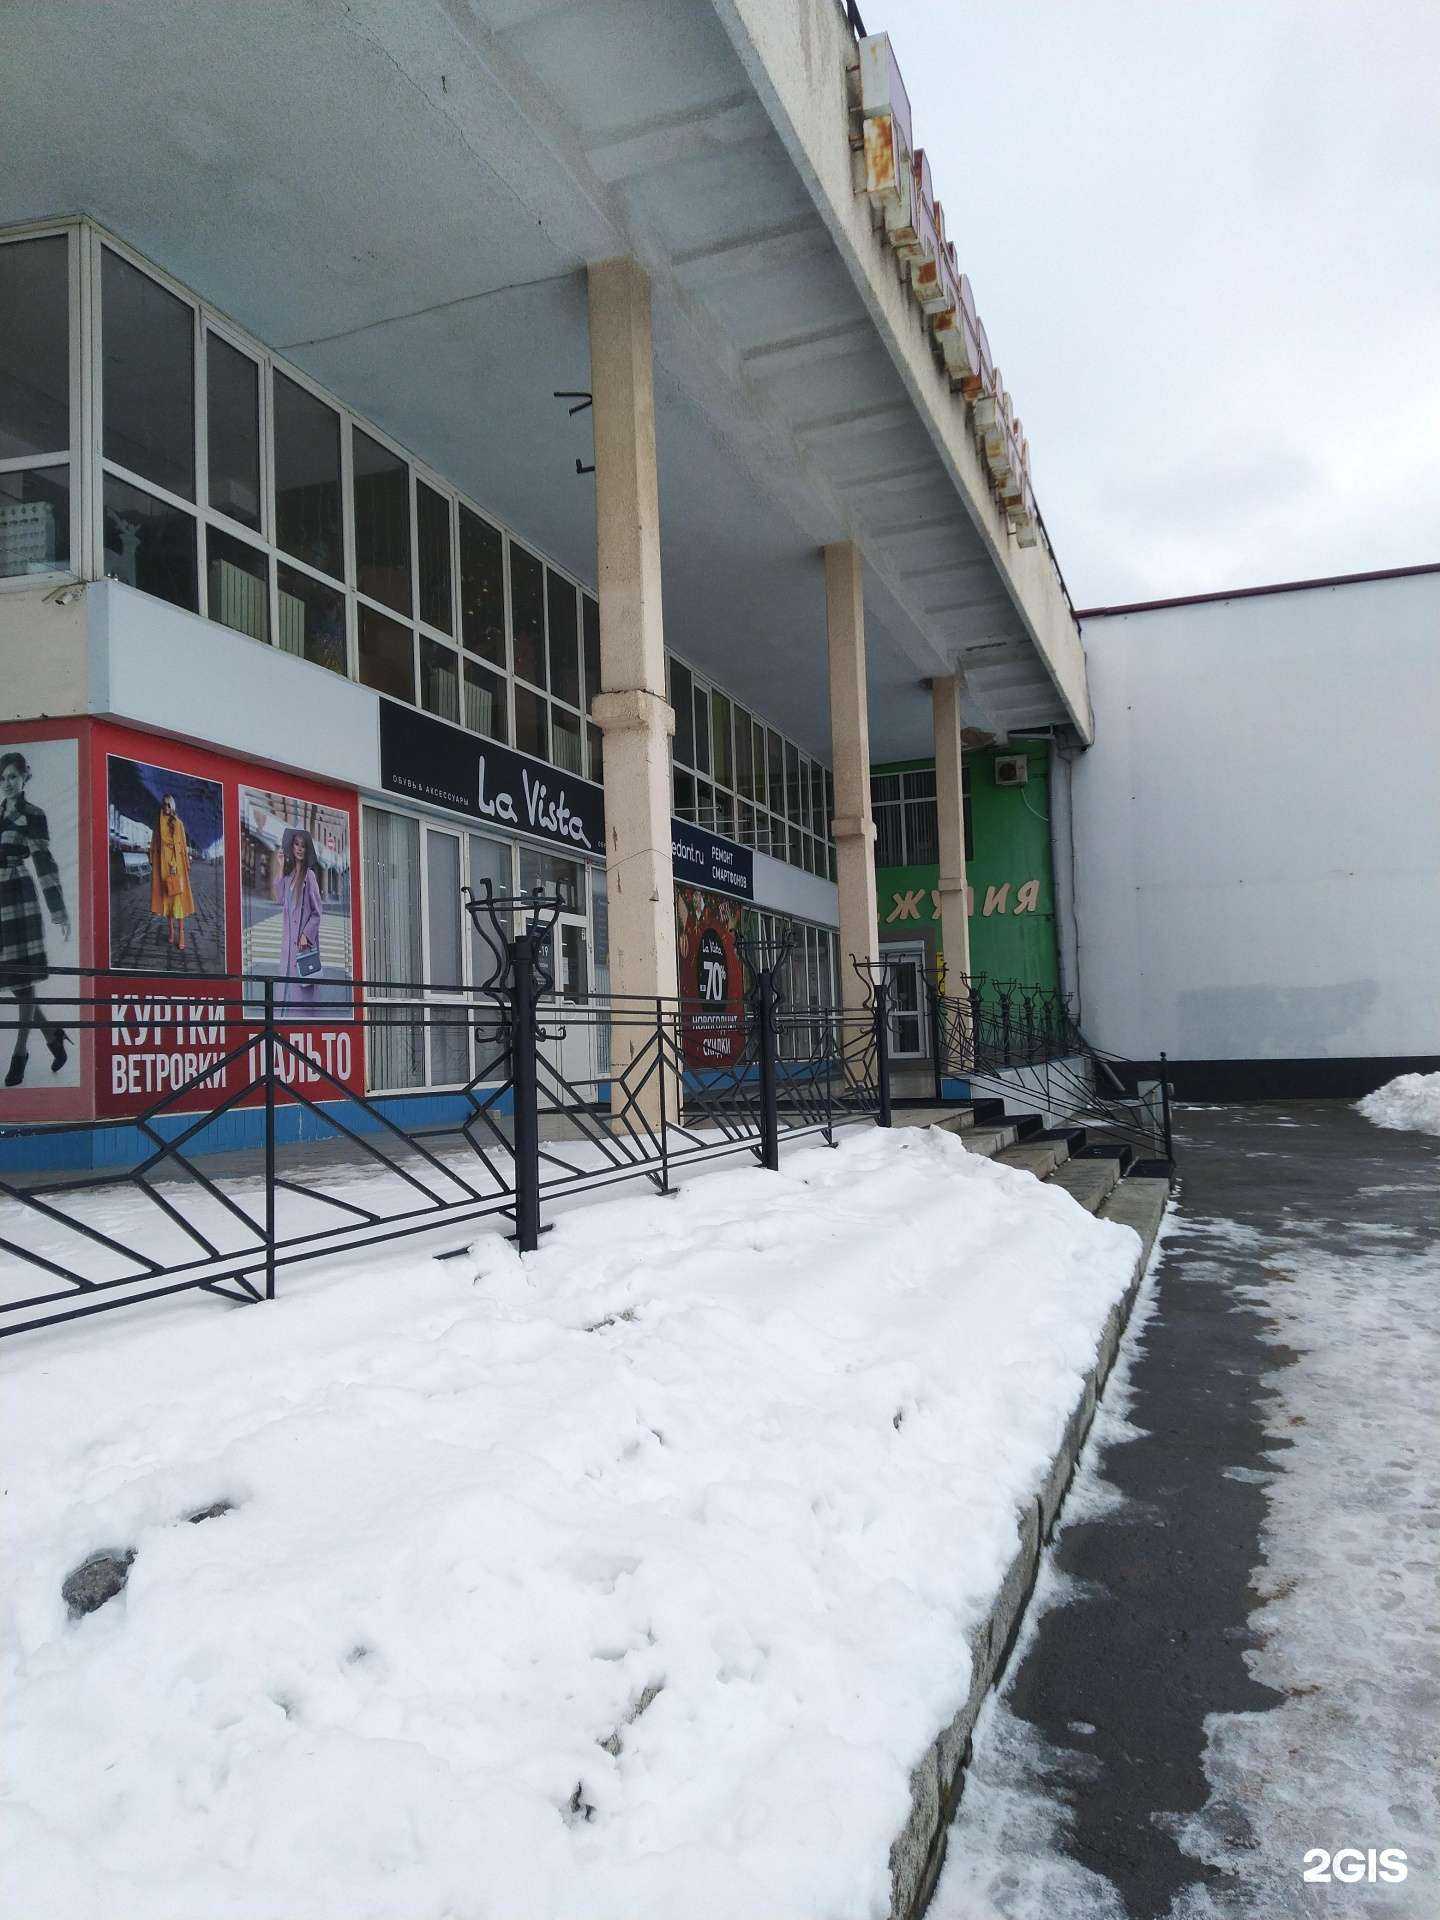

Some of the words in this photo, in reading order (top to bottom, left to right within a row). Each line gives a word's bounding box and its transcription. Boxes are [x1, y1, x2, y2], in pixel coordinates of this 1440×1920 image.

[392, 774, 417, 789] ОБУВЬ
[425, 785, 469, 806] АКСЕССУАРЫ
[478, 755, 518, 823] La
[521, 768, 592, 849] Vista
[671, 839, 705, 865] edant.ru
[711, 845, 734, 866] РЕМОНТ
[712, 865, 747, 889] СМАРТФОНОВ
[111, 993, 226, 1046] КУРТКИ
[248, 1032, 352, 1085] ПАЛЬТО
[702, 1037, 731, 1059] СКИДКИ
[111, 1052, 227, 1095] ВЕТРОВКИ
